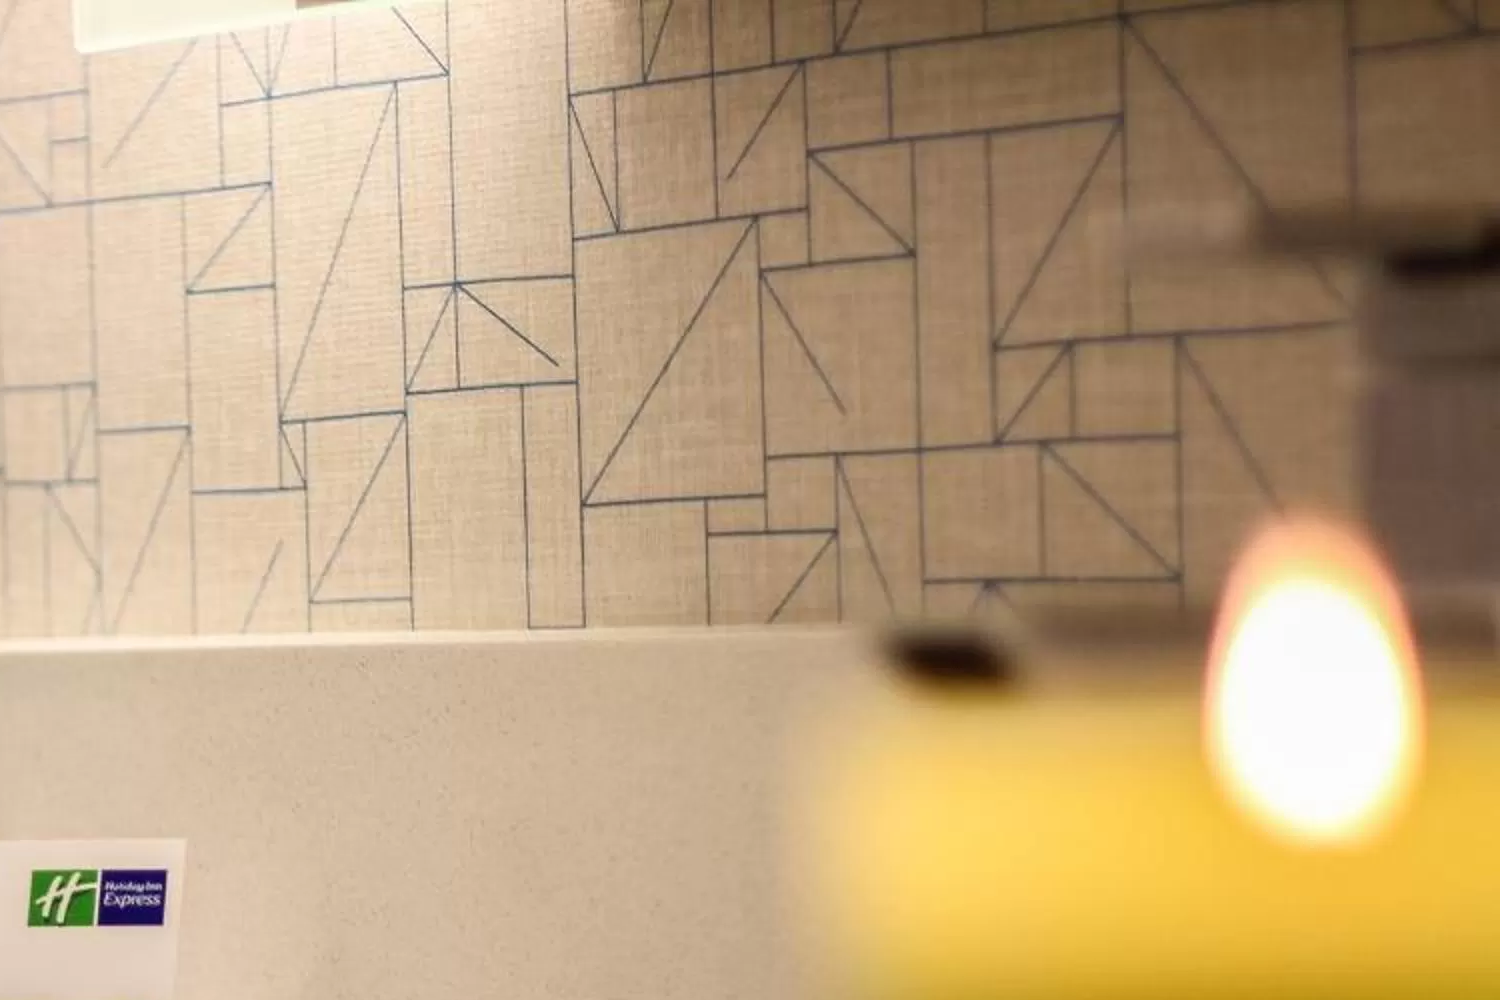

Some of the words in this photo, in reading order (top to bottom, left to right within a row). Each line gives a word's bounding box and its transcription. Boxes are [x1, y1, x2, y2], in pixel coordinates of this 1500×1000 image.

[104, 881, 144, 893] Holiday
[145, 881, 163, 891] Inn
[103, 892, 161, 908] Express
